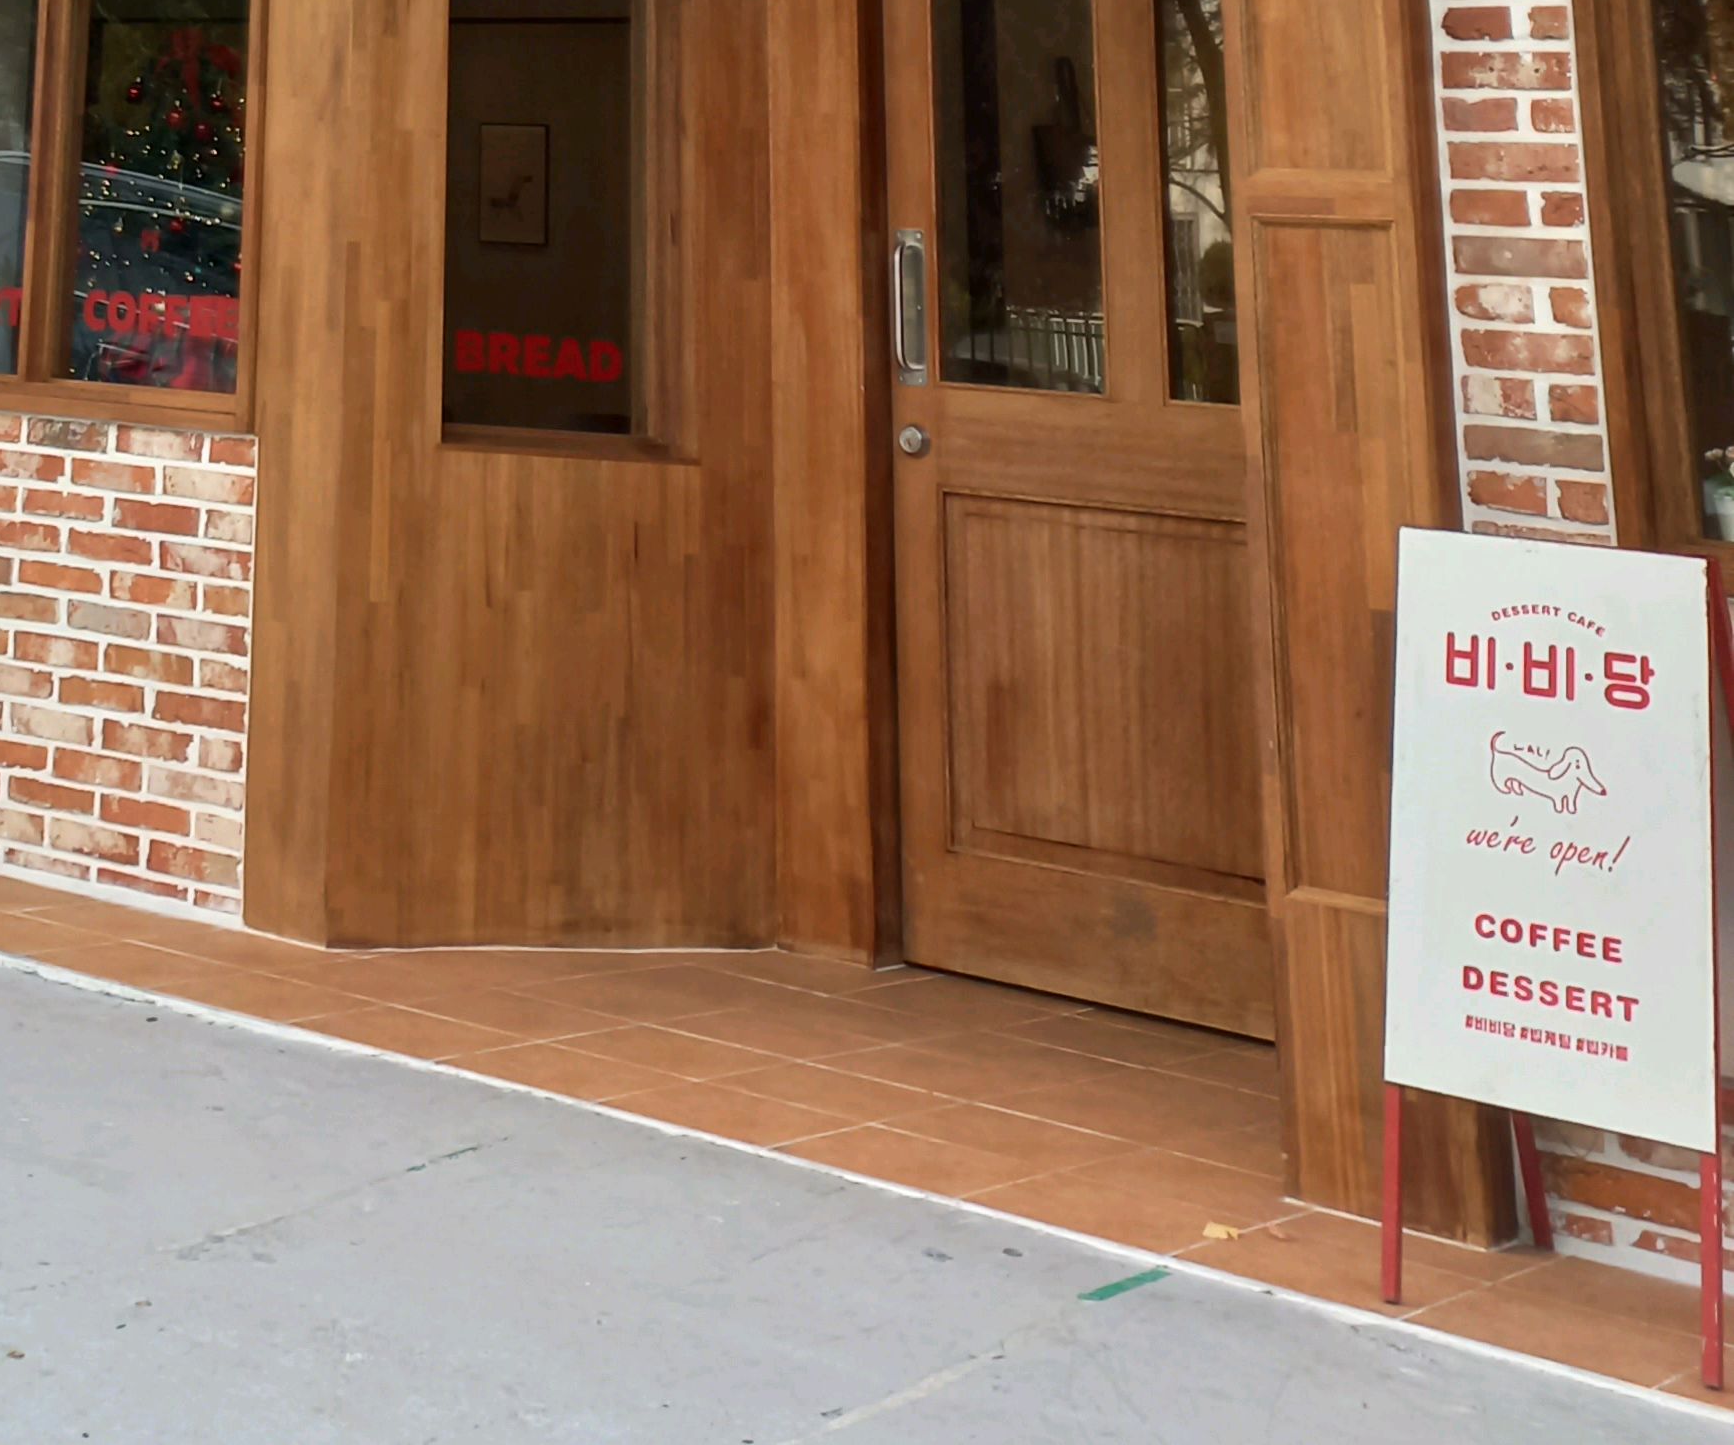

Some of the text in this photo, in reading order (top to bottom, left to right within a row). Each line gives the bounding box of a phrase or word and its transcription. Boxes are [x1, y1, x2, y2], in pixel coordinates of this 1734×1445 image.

[83, 289, 240, 339] COFFEE
[455, 329, 623, 383] BREAD
[1491, 604, 1607, 638] DESSERT CAFE
[1466, 815, 1631, 876] we're open!
[1474, 913, 1624, 964] COFFEE
[1462, 965, 1640, 1022] DESSERT
